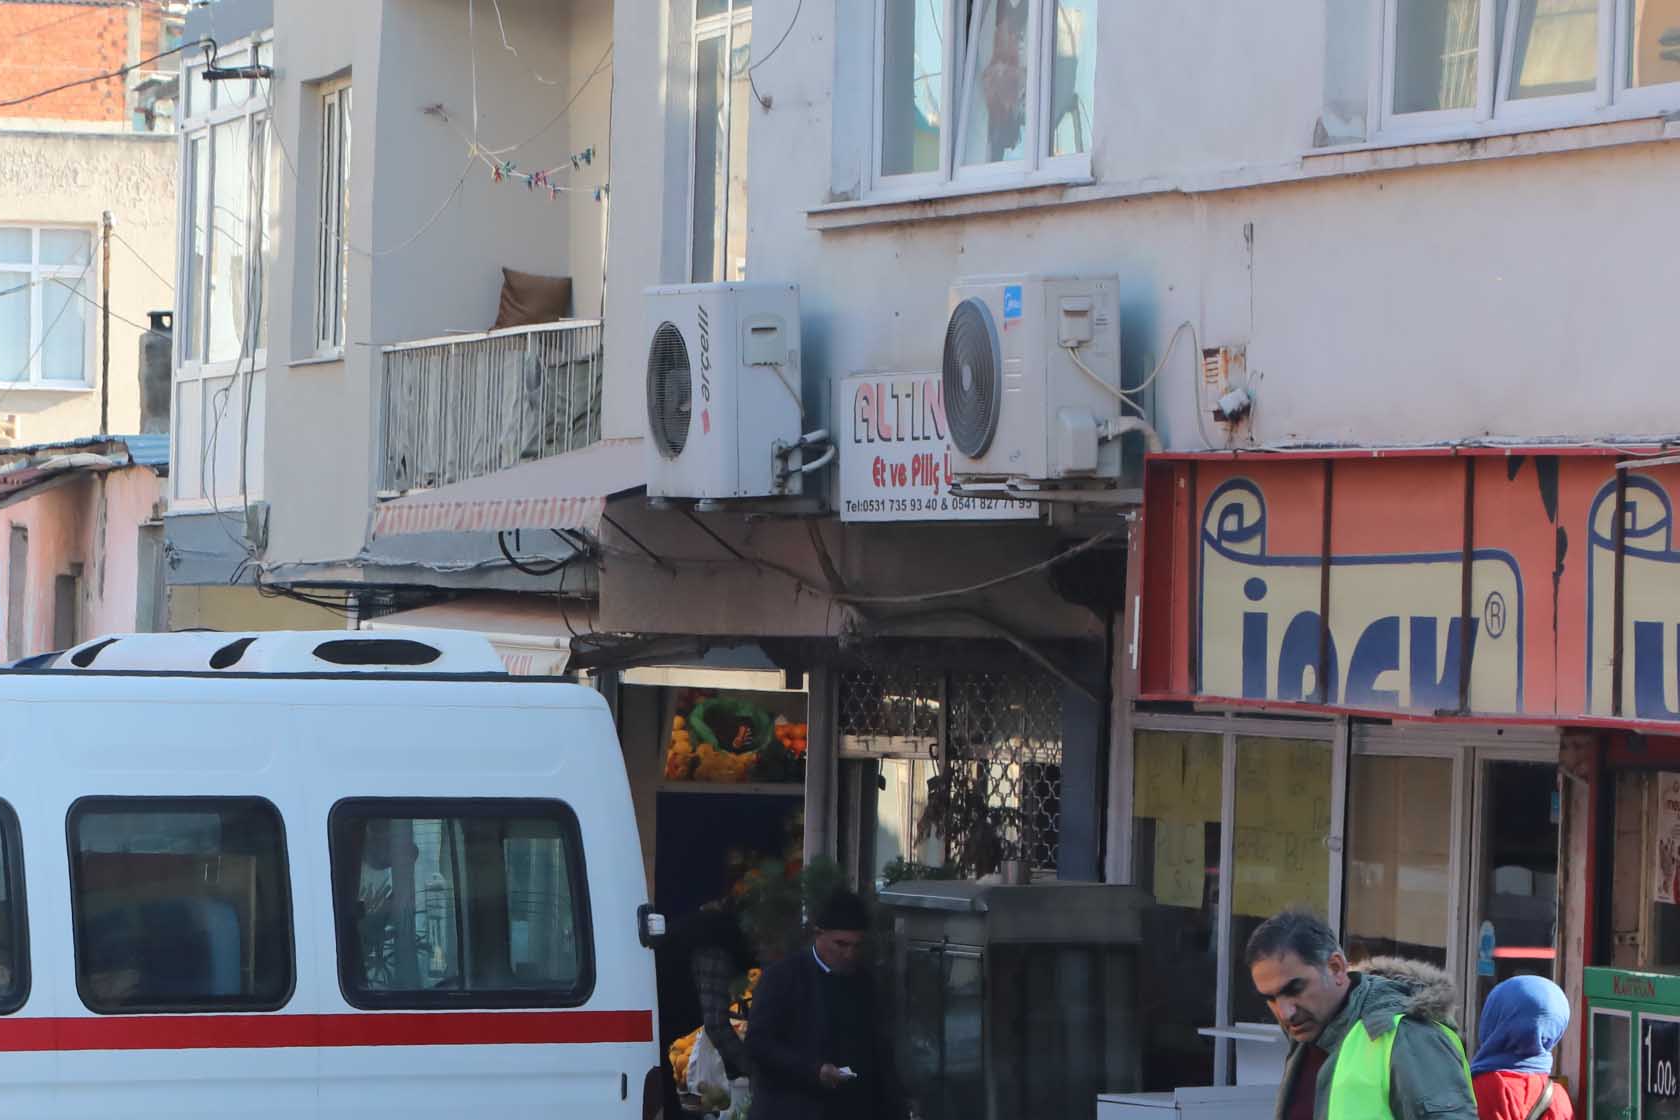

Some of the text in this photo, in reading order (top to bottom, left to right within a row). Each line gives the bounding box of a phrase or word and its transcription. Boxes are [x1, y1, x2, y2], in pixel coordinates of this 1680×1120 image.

[872, 455, 886, 487] Et
[890, 462, 907, 487] ve
[911, 452, 939, 495] Piliç
